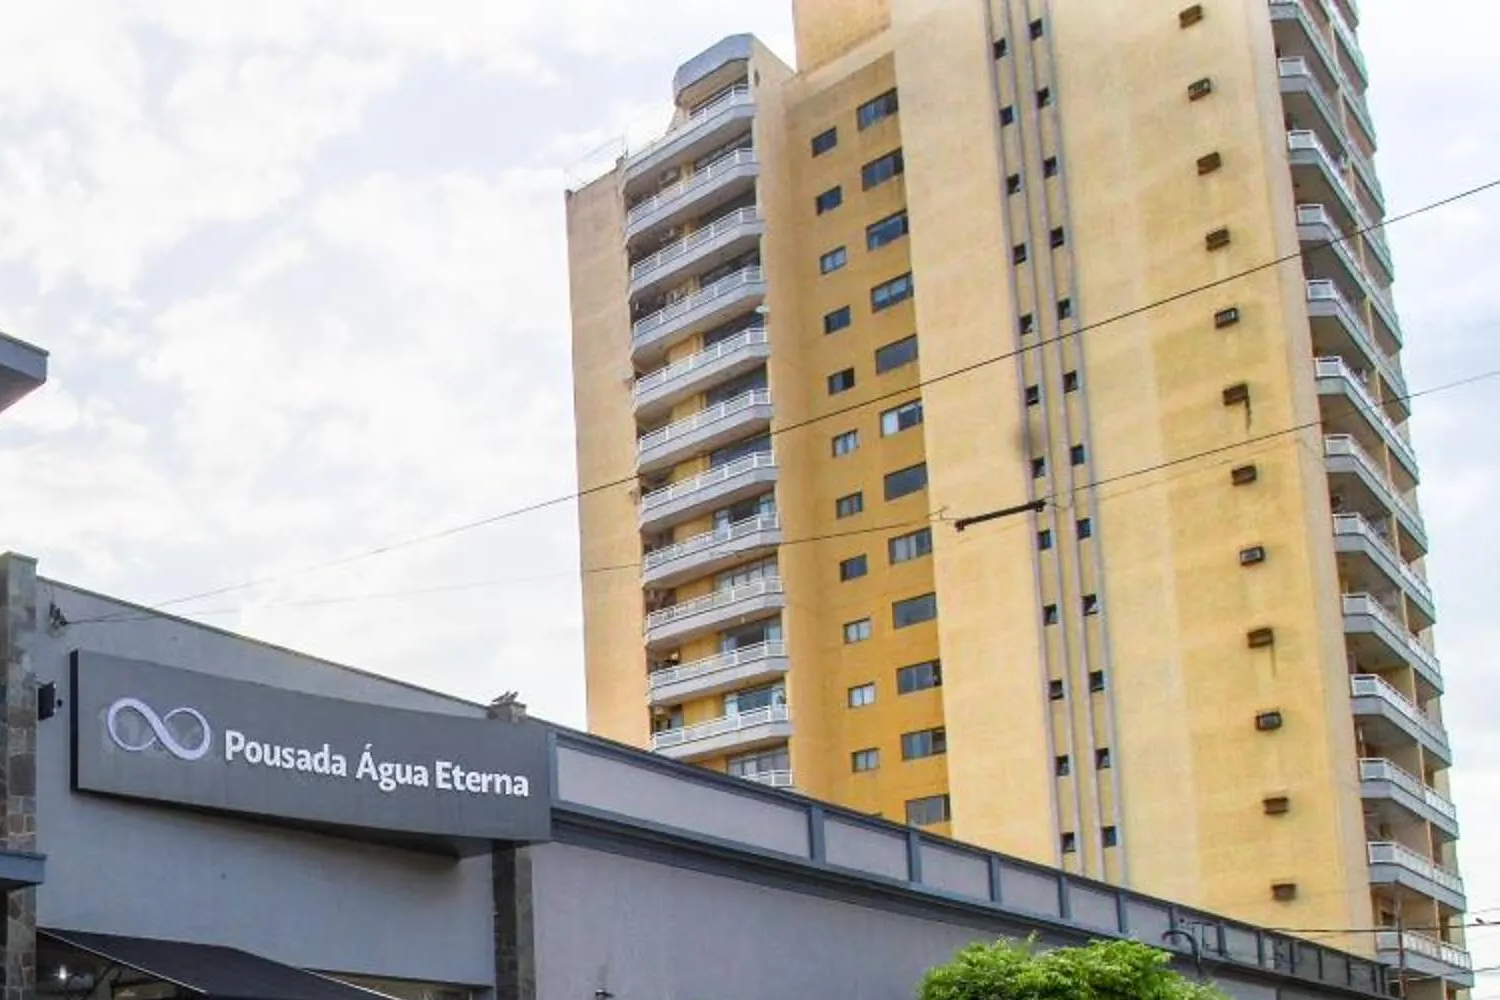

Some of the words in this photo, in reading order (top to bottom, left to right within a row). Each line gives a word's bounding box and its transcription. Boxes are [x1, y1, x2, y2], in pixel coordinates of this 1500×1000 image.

[224, 729, 347, 777] Pousada
[356, 742, 429, 792] Água
[436, 760, 529, 798] Eterna
